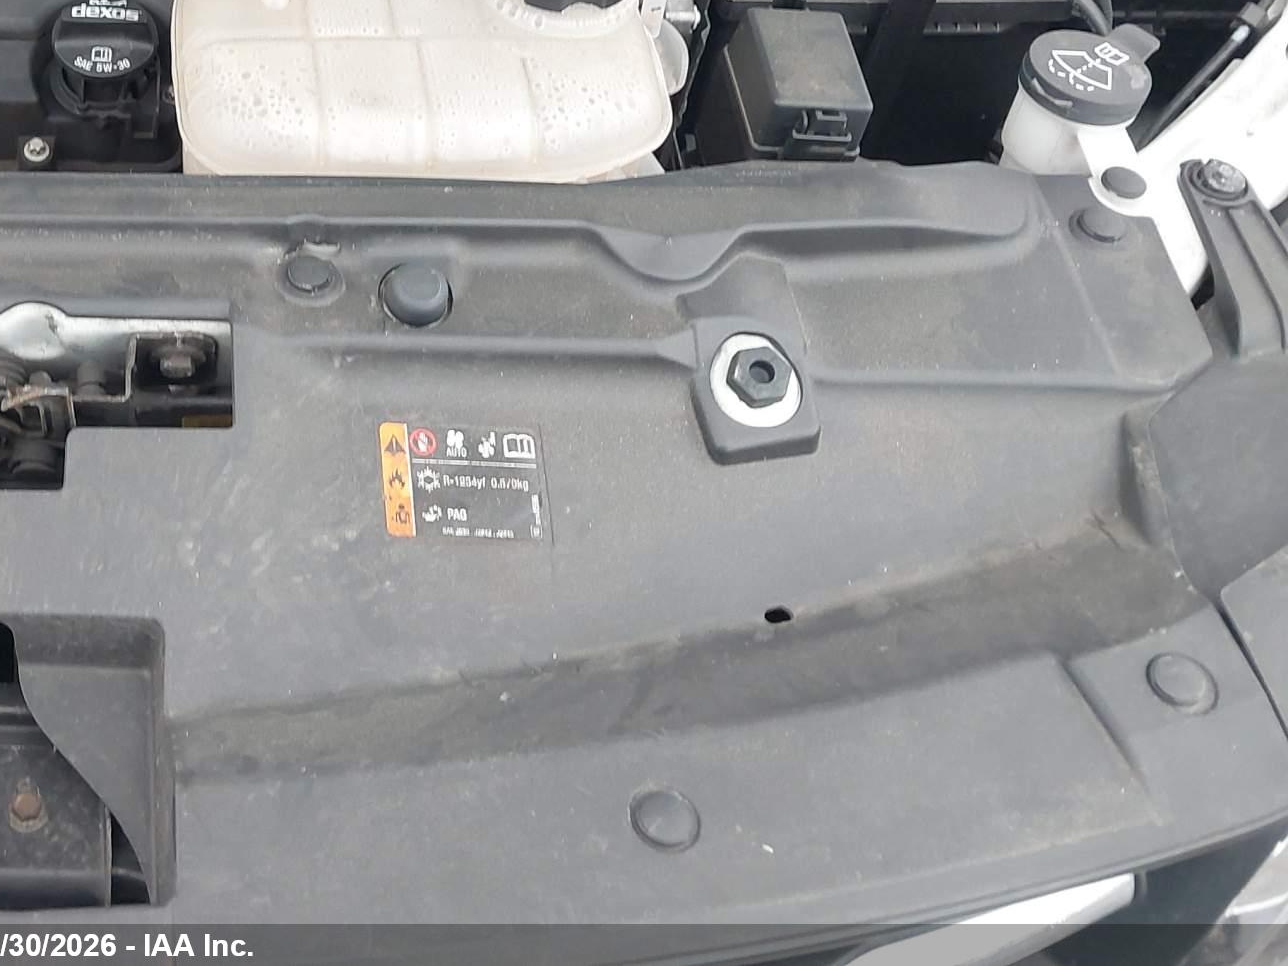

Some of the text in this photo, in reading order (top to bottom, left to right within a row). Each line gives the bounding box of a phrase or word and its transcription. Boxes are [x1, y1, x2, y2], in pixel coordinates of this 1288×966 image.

[71, 2, 139, 21] dexos
[73, 55, 93, 71] SAE
[446, 446, 467, 458] AUTO
